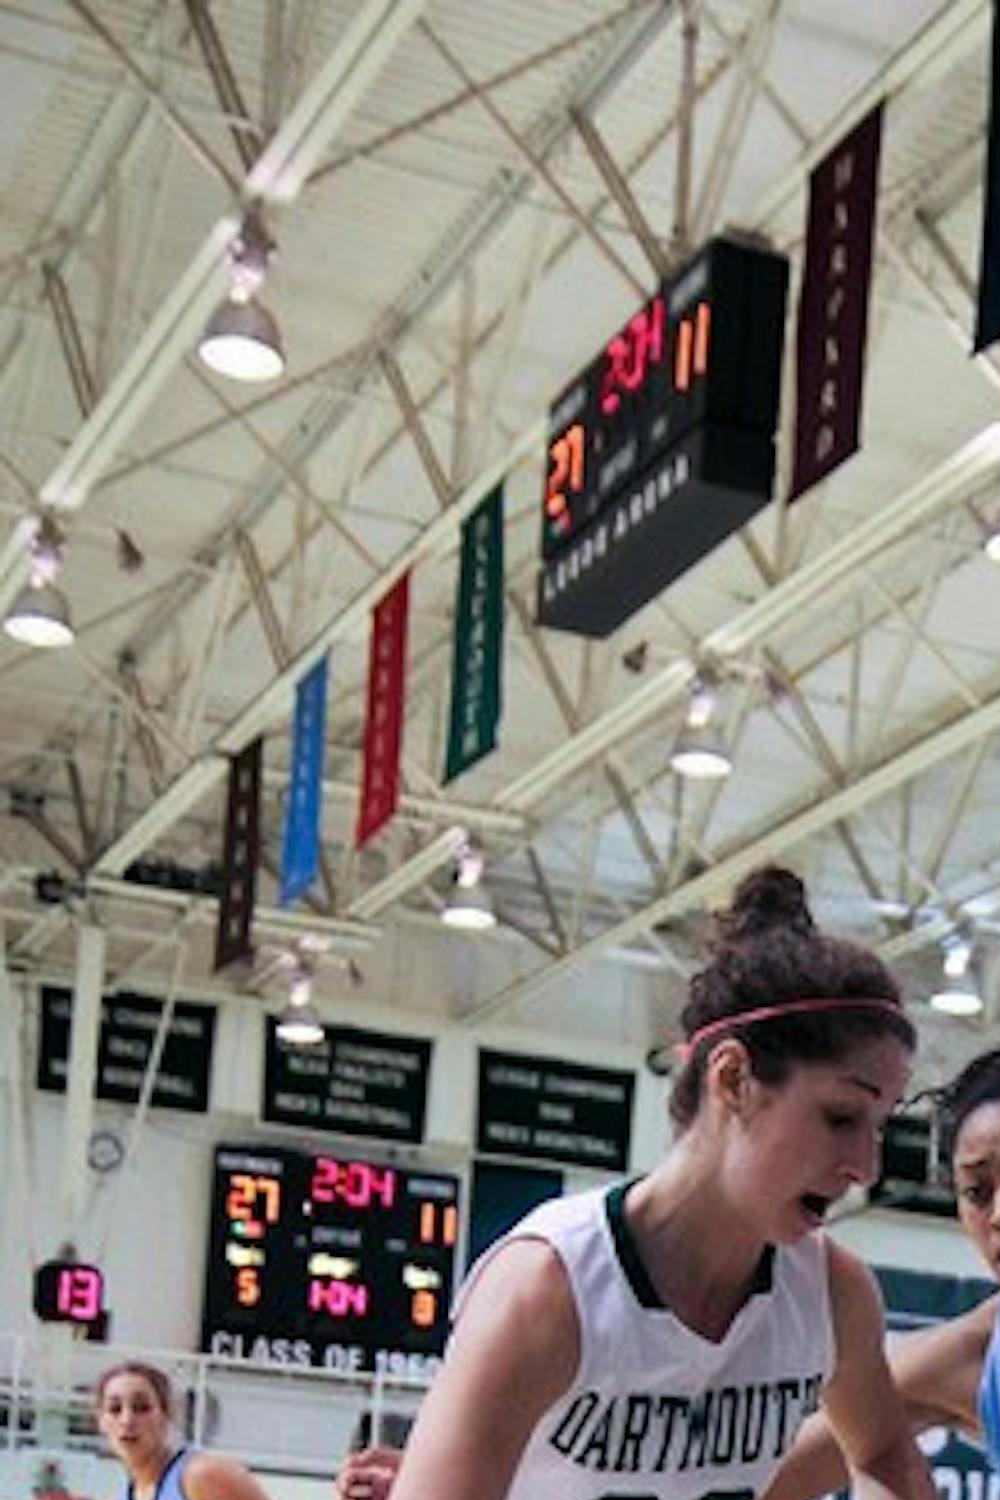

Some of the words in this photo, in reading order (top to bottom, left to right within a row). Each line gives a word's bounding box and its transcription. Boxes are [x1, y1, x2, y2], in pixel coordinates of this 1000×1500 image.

[227, 1174, 281, 1224] 27
[311, 1157, 396, 1208] 2:04
[419, 1202, 457, 1248] 11
[57, 1268, 101, 1320] 13
[210, 1330, 314, 1370] CLASS
[324, 1343, 364, 1373] OF
